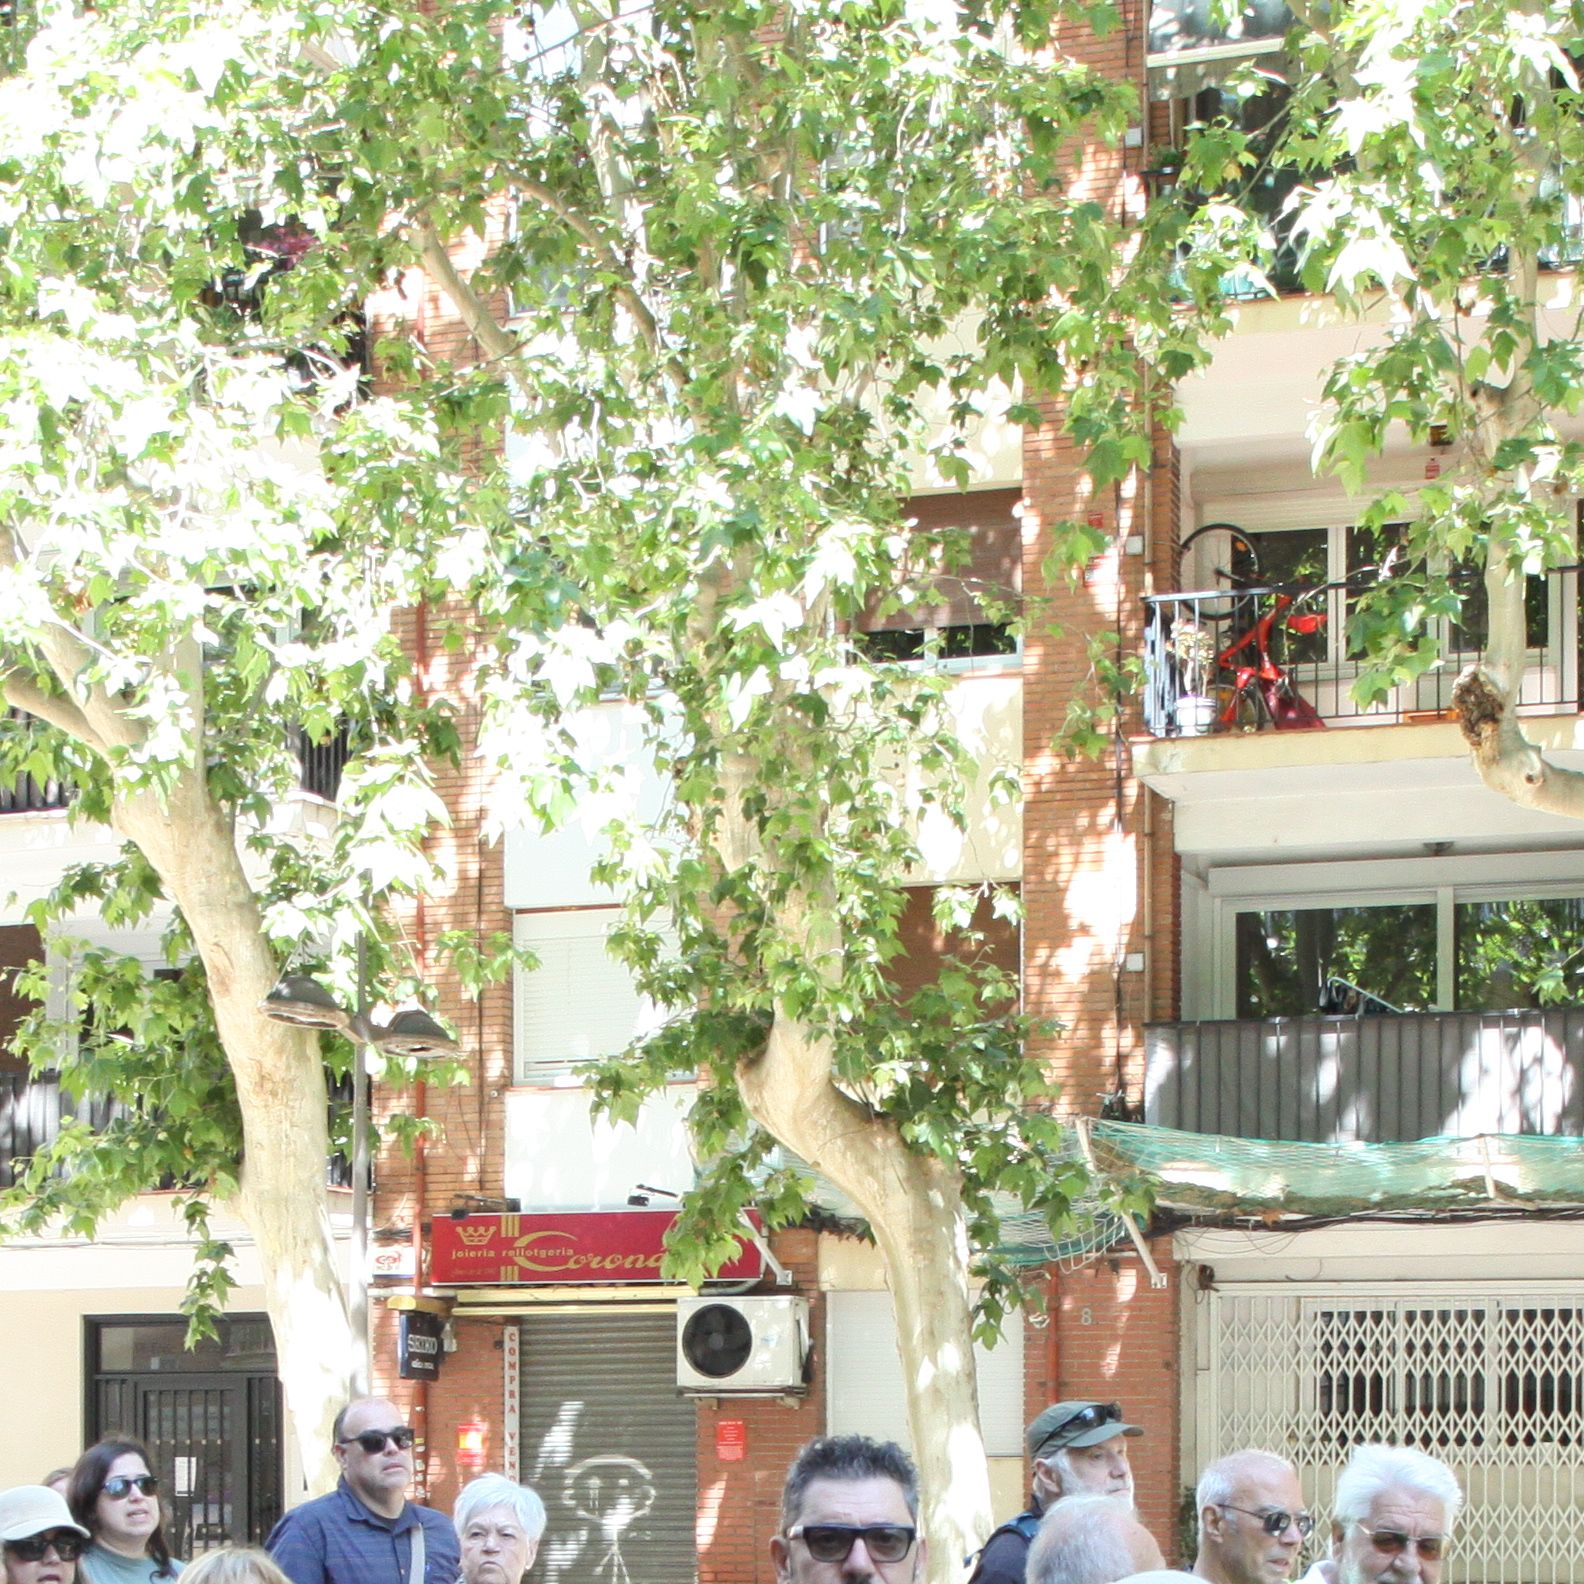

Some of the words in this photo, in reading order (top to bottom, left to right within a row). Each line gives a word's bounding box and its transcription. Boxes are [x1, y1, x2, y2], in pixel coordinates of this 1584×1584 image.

[451, 1247, 496, 1260] joieria
[501, 1246, 574, 1259] rellotgeria
[508, 1332, 517, 1414] COMPRA
